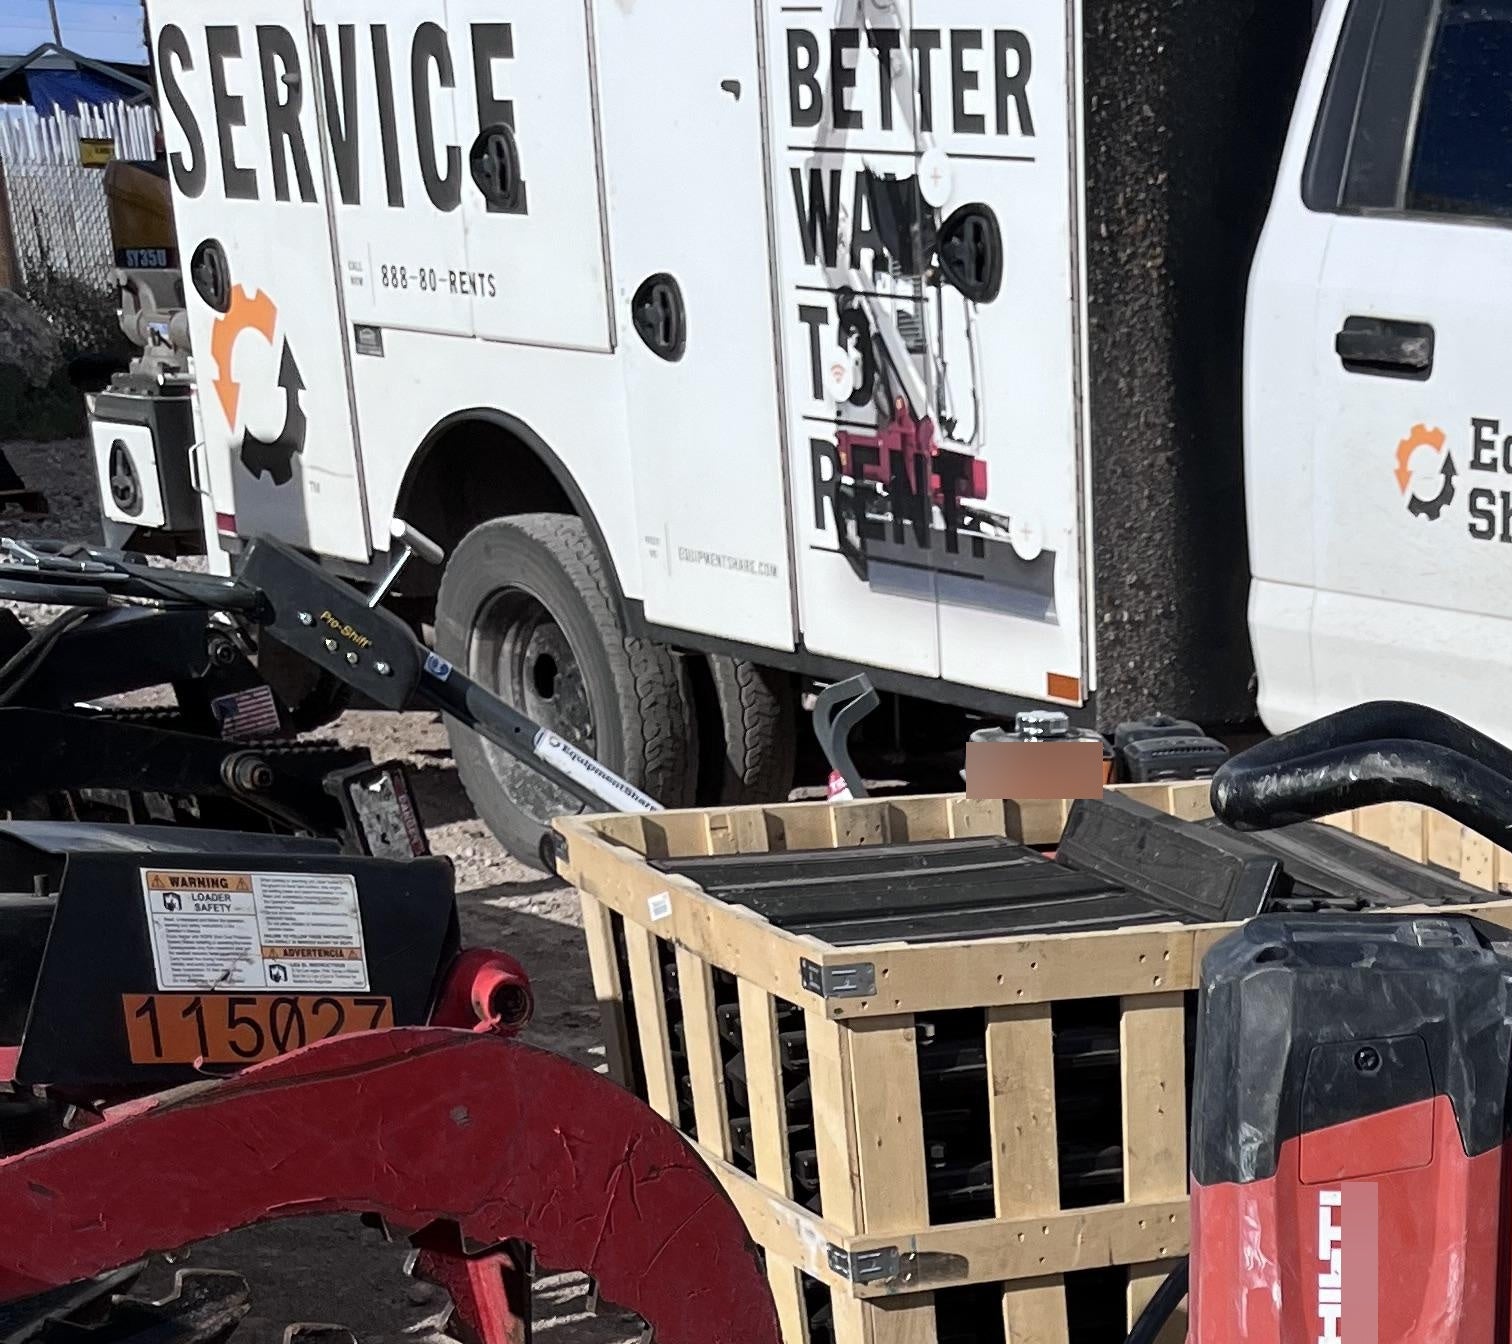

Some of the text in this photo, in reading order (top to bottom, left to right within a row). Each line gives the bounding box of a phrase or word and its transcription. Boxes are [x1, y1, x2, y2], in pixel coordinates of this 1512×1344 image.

[786, 28, 1035, 137] BETTER
[158, 22, 528, 214] SERVICE
[381, 264, 496, 298] 888-80-RENTS
[169, 876, 229, 889] WARNING
[191, 892, 232, 902] LOADER
[194, 902, 232, 913] SAFETY
[283, 948, 344, 958] ADVERTENCIA
